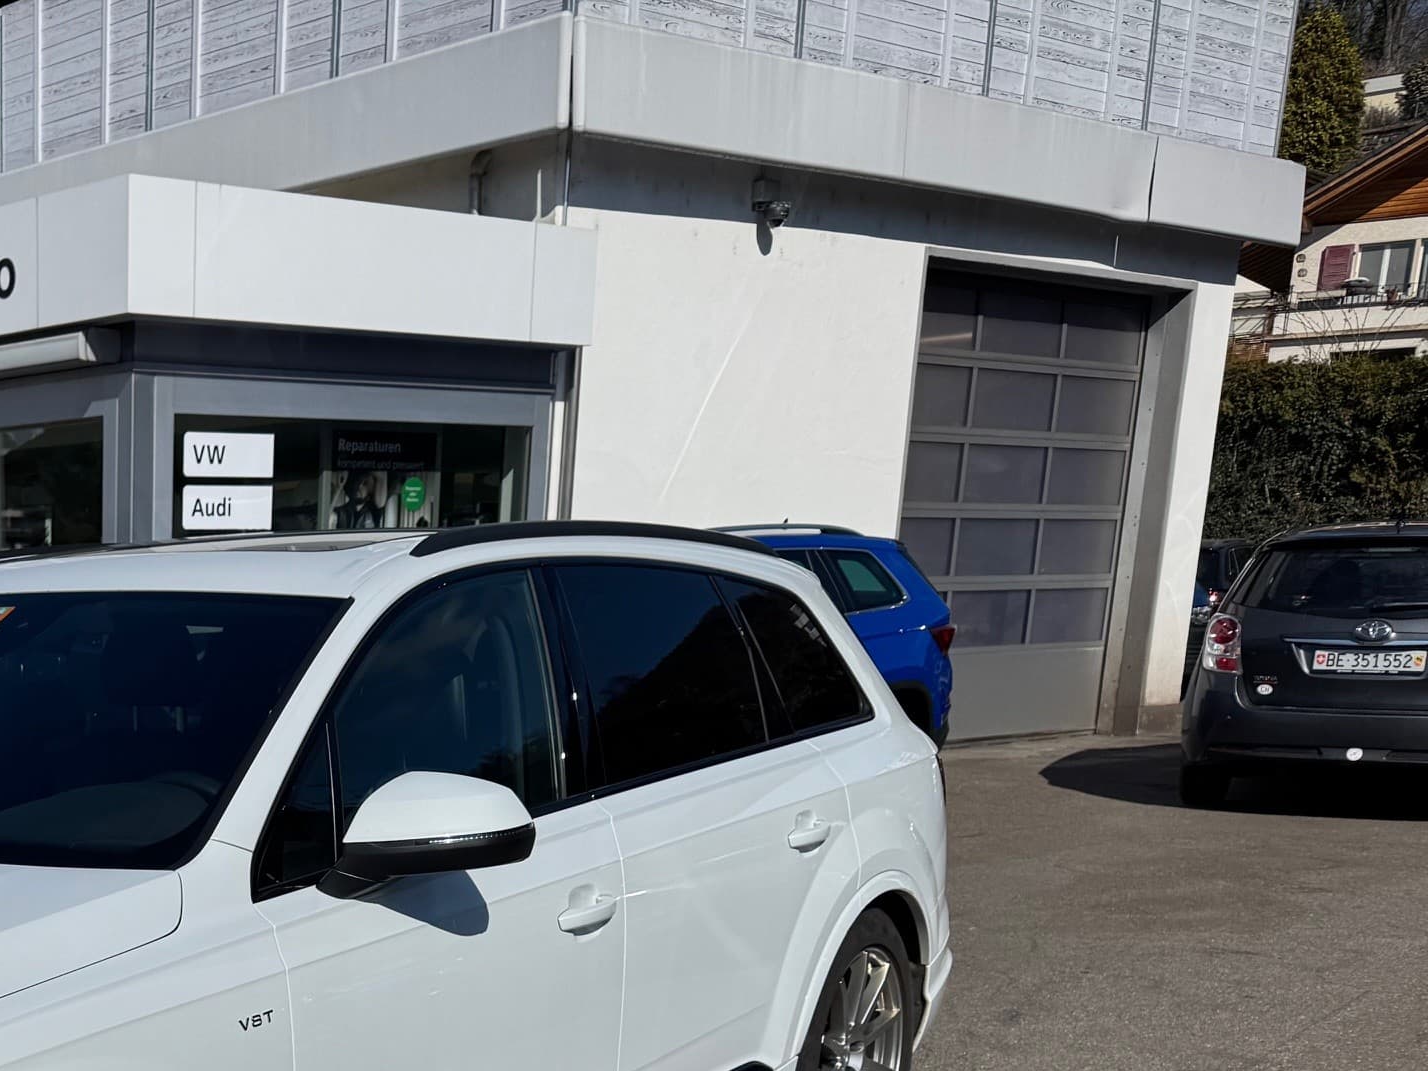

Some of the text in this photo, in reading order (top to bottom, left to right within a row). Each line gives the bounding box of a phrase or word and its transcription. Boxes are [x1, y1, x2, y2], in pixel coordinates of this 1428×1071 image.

[193, 444, 226, 465] VW
[338, 438, 402, 454] Reparaturen
[191, 496, 232, 517] Audi
[238, 1009, 274, 1031] V8T
